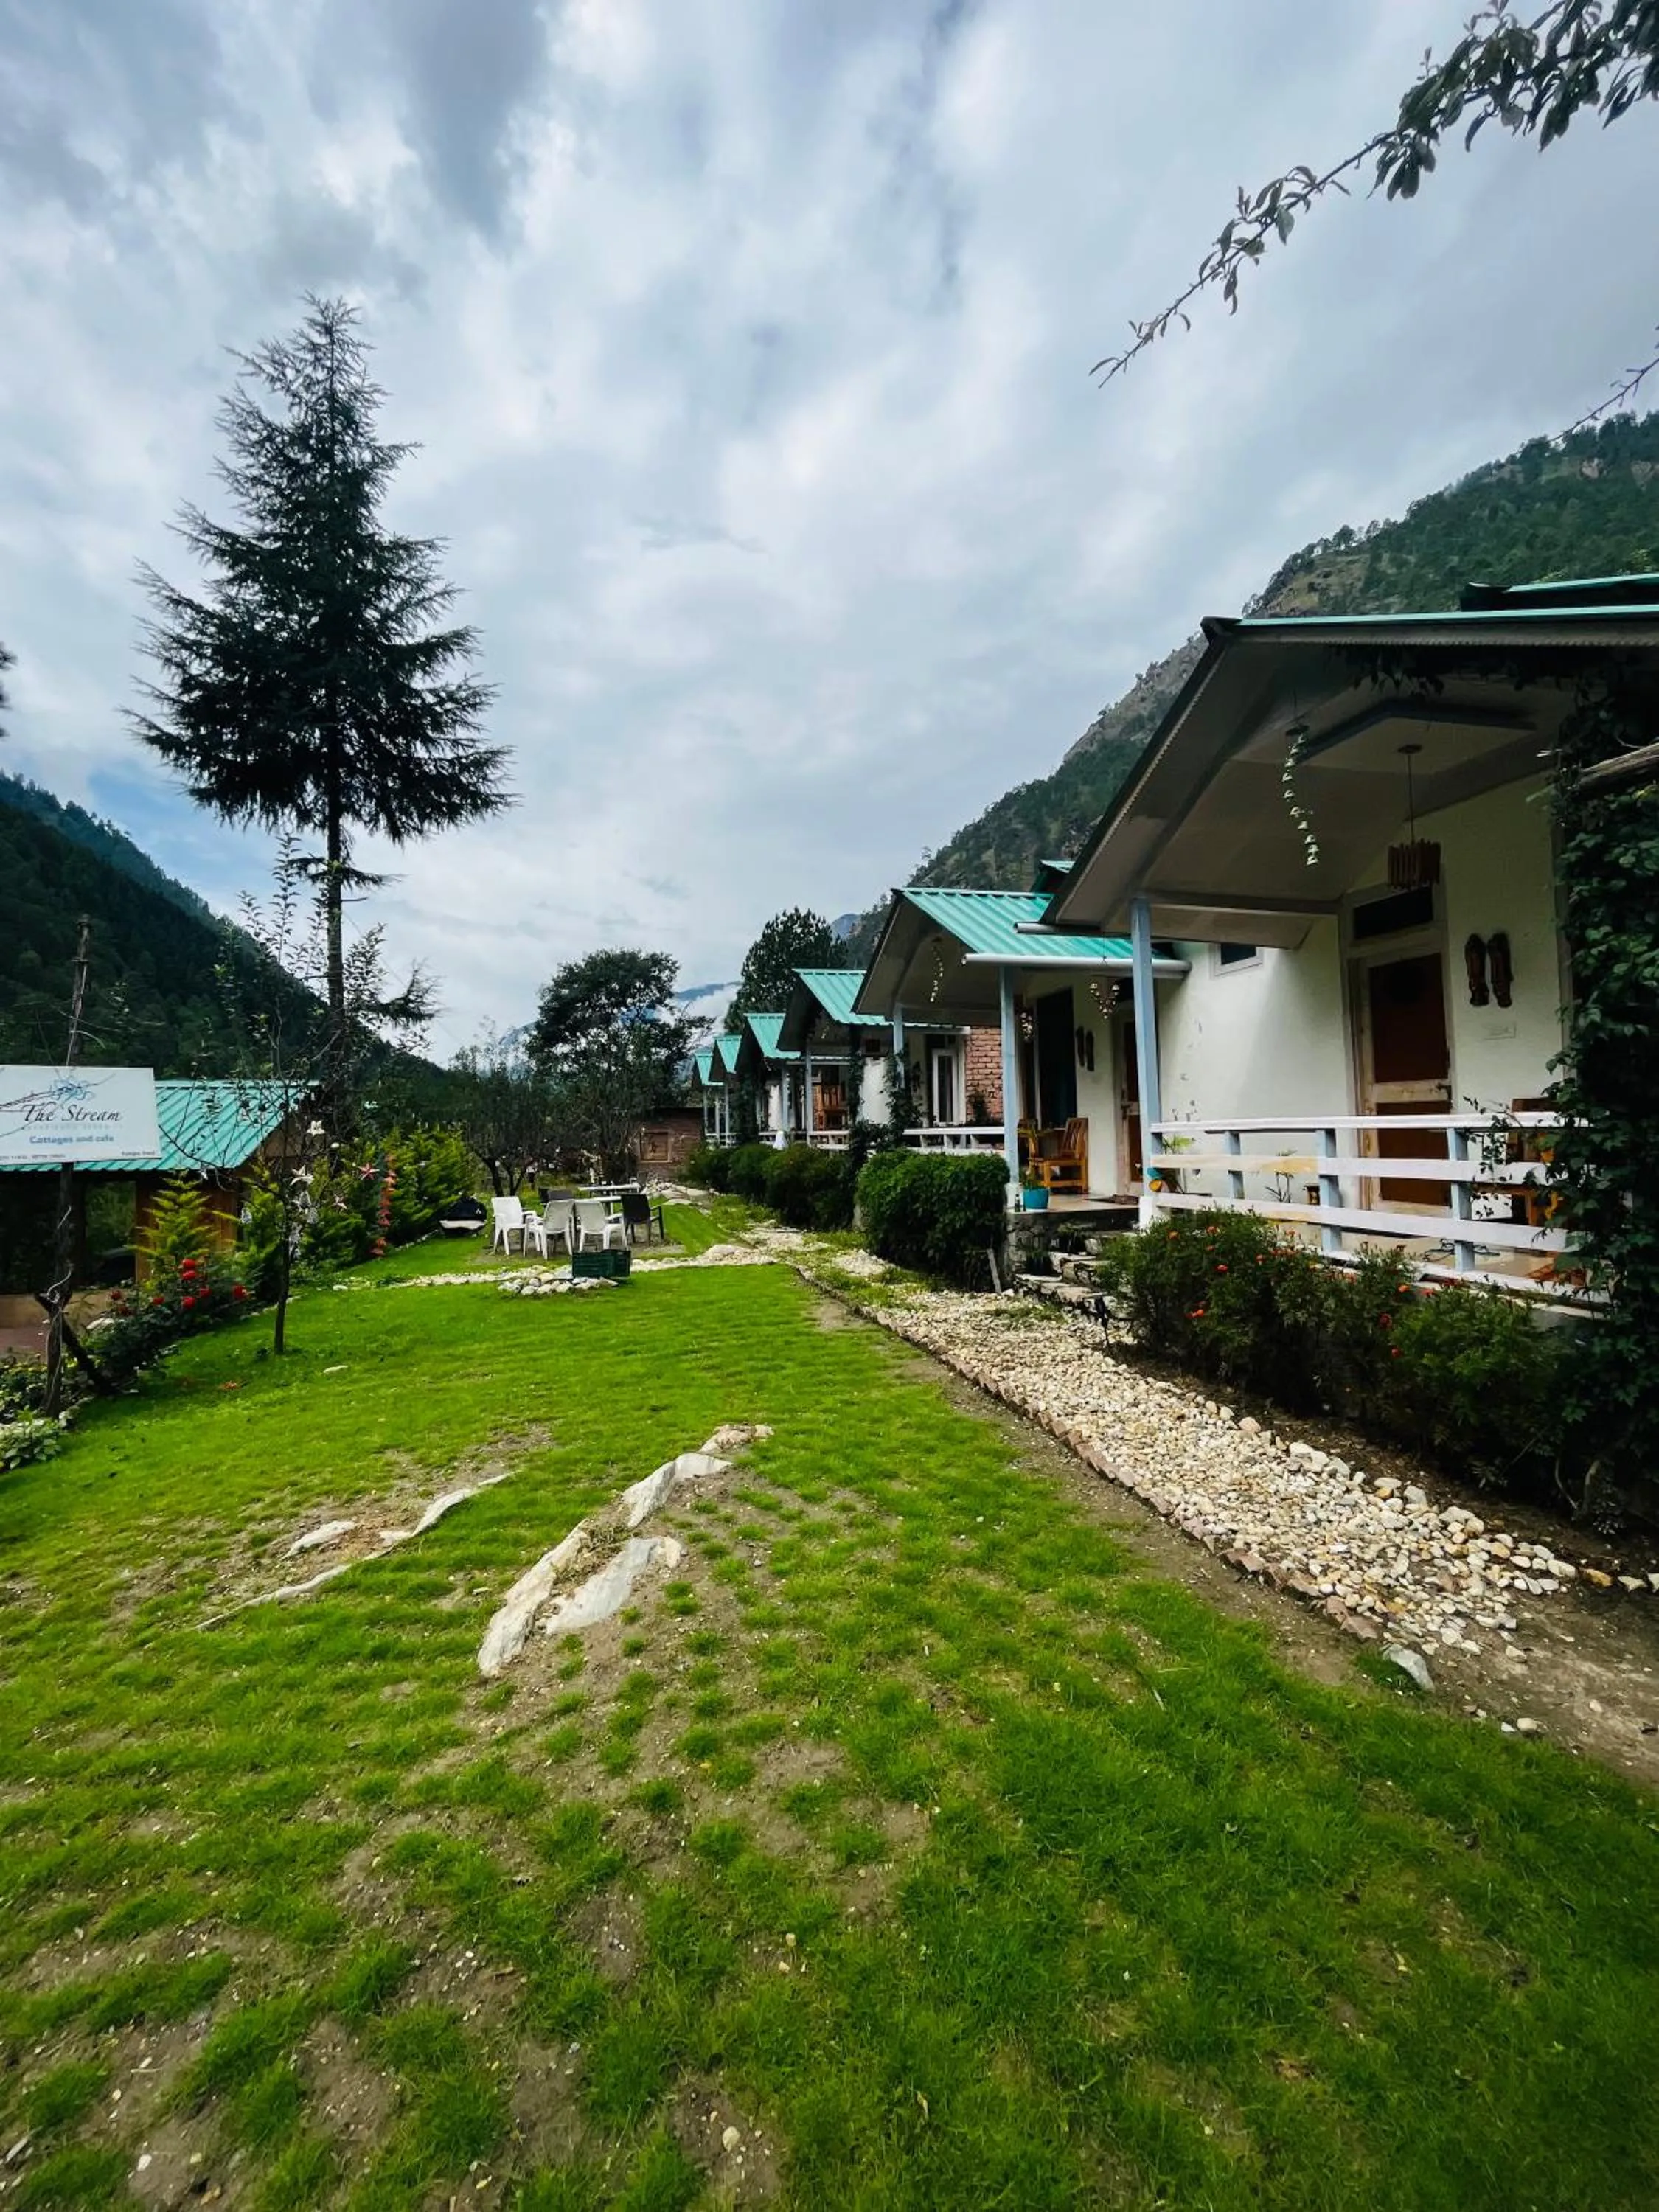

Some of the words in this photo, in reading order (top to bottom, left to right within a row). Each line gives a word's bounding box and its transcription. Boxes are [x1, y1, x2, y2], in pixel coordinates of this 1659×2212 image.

[23, 1102, 57, 1121] The
[61, 1105, 120, 1121] Stream
[29, 1135, 73, 1144] Cottages
[76, 1135, 93, 1143] and
